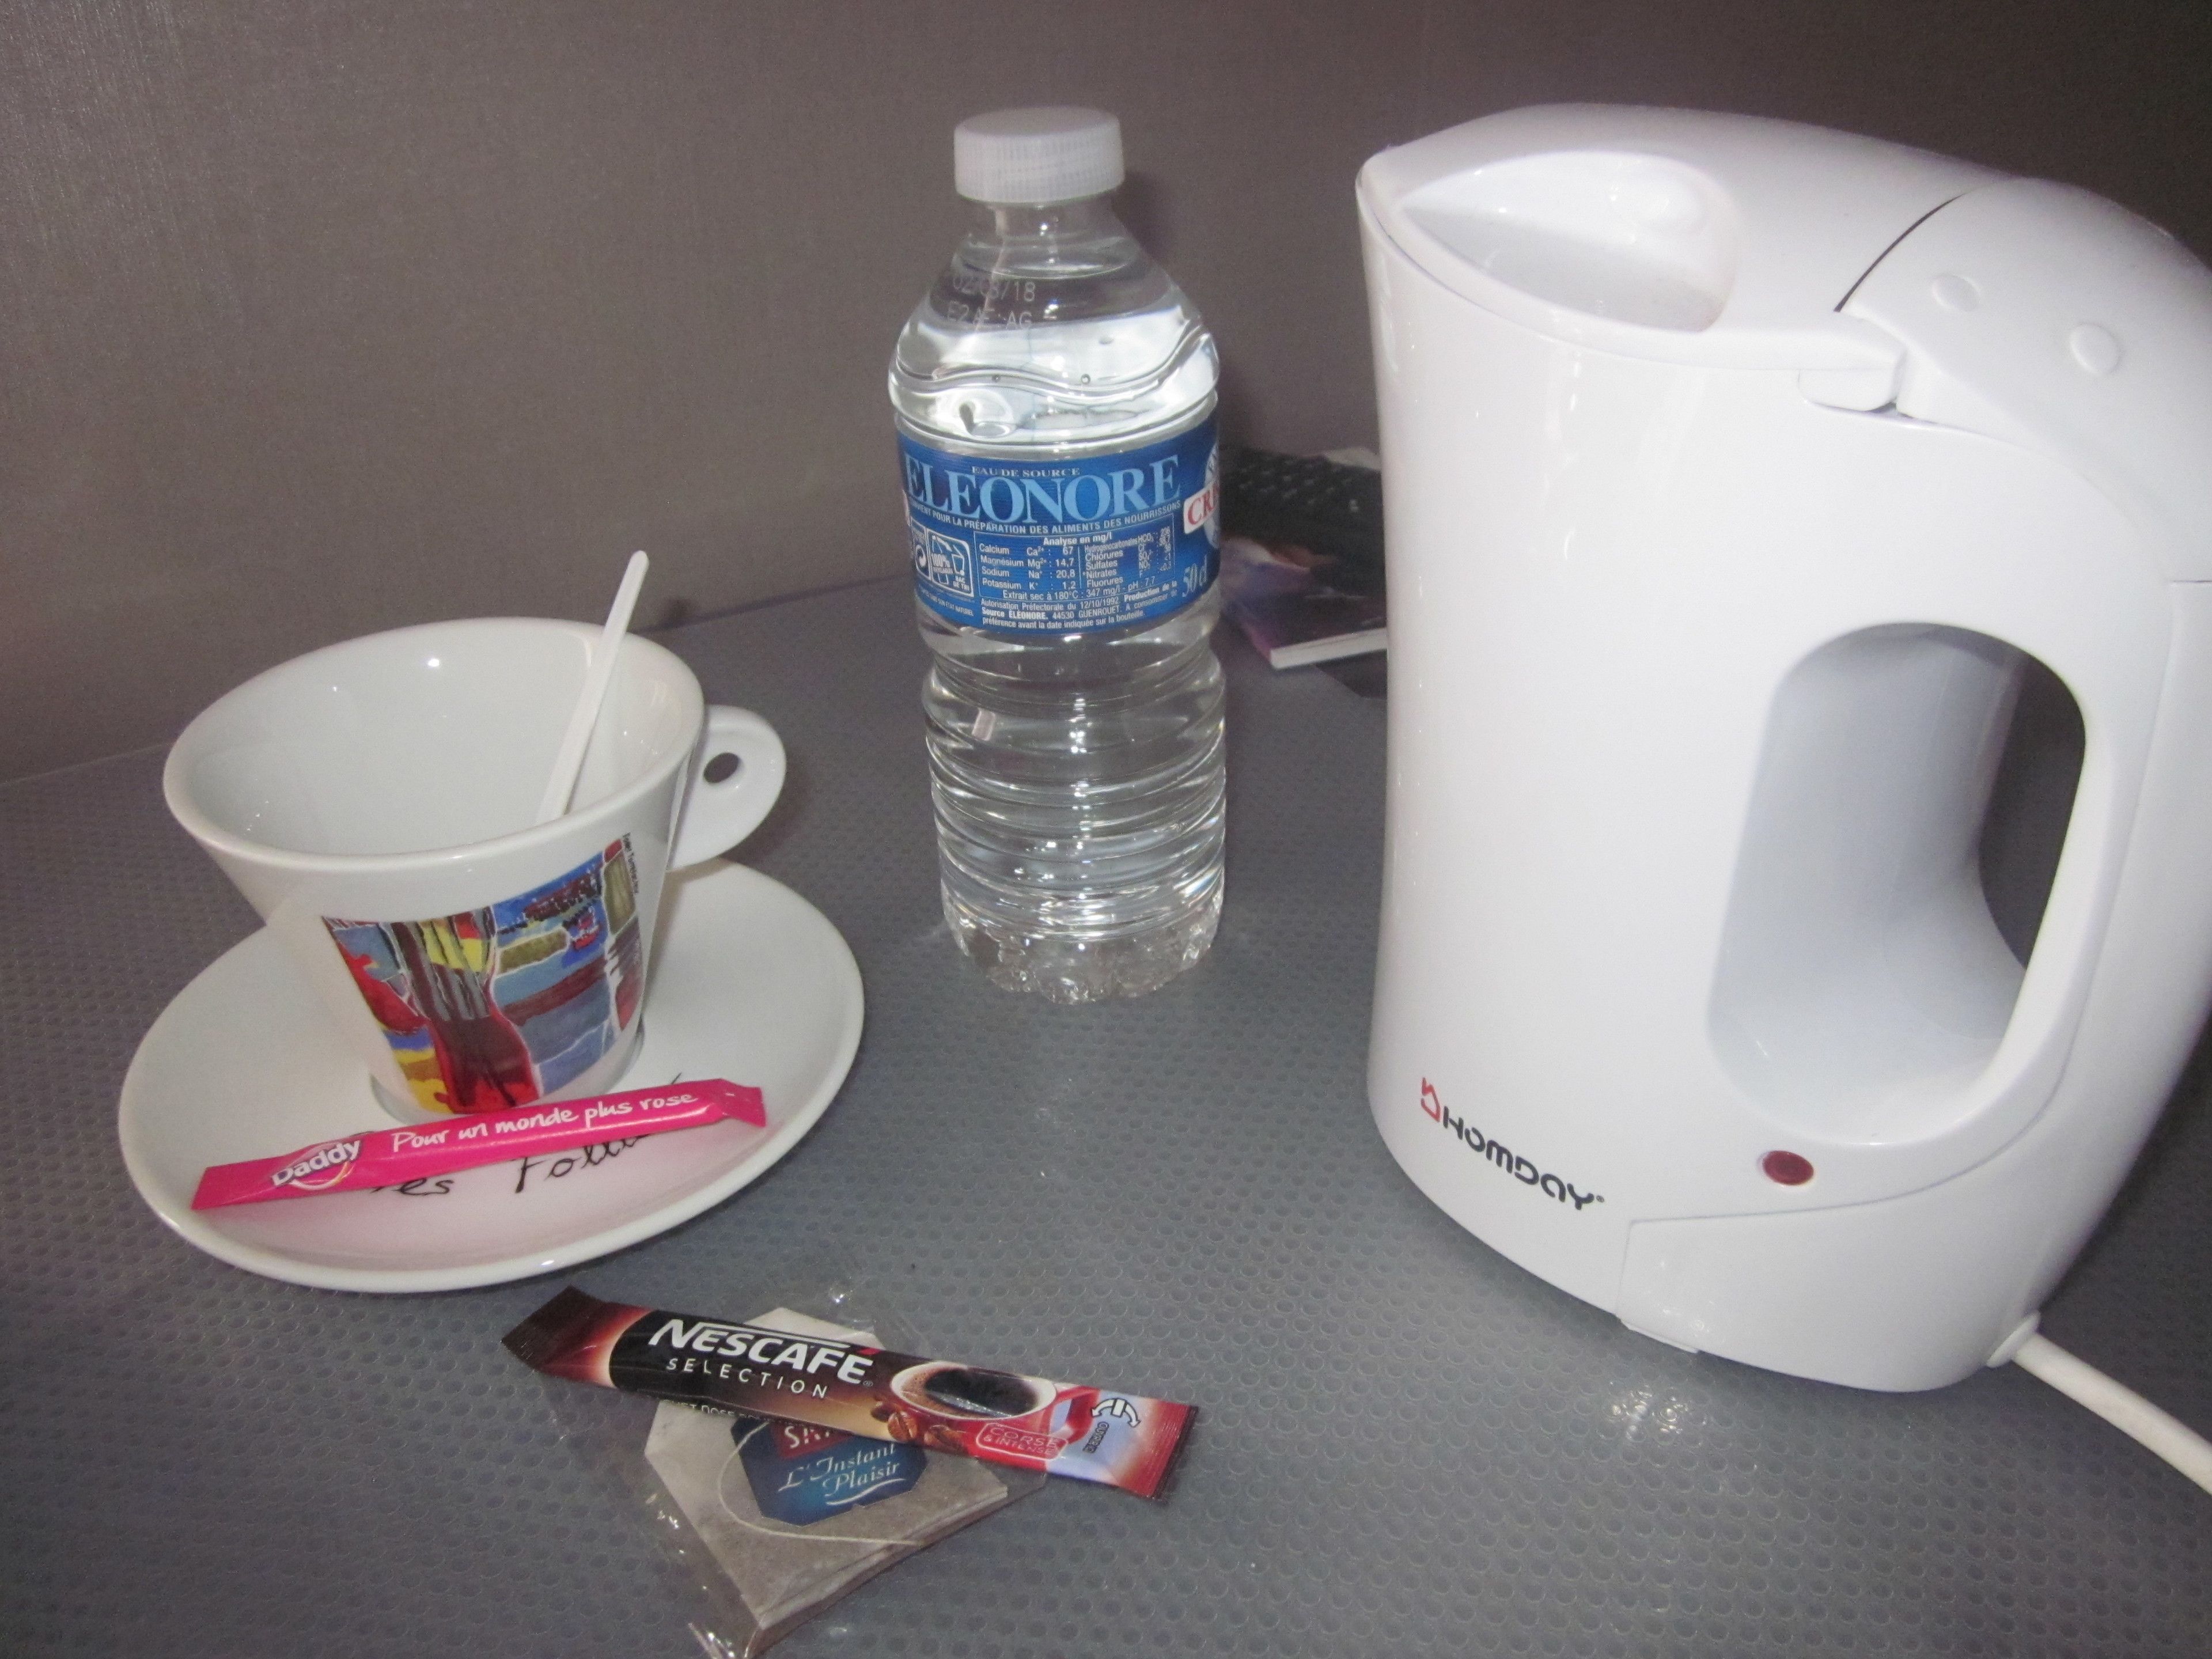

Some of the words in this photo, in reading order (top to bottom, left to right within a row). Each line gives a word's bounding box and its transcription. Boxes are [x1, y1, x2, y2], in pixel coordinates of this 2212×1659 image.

[971, 465, 998, 475] EAU
[1001, 469, 1019, 477] DE
[1022, 468, 1081, 478] SOURCE
[932, 511, 951, 524] POUR
[952, 516, 963, 527] LA
[964, 520, 1027, 534] PRÉPARATION
[1029, 525, 1048, 534] DES
[1051, 521, 1101, 534] ALIMENTS
[1104, 517, 1122, 529] DES
[1124, 501, 1181, 524] NOURRISSONS
[1043, 537, 1077, 546] Analyse
[1092, 532, 1112, 543] mg/l
[979, 543, 1010, 555] Calcium
[1062, 546, 1074, 555] 67
[980, 555, 1024, 567] Magnésium
[1055, 558, 1074, 567] 14,7
[1085, 550, 1124, 562] Chlorures
[1086, 560, 1118, 571] Sulfates
[982, 566, 1010, 577] Sodium
[1056, 569, 1075, 579] 20,8
[982, 578, 1021, 589] Potassium
[1062, 581, 1076, 590] 1,2
[1086, 577, 1124, 588] Fluorures
[1003, 590, 1028, 600] Extrait
[1047, 592, 1052, 600] à
[1086, 588, 1100, 597] 347
[1103, 584, 1120, 596] mg/l
[1128, 580, 1138, 592] pH
[981, 598, 1019, 610] Autorisation
[1022, 602, 1064, 611] Préfectorale
[1067, 601, 1077, 609] du
[1124, 586, 1160, 603] Production
[982, 607, 1005, 617] Source
[1052, 611, 1074, 619] 44530
[982, 616, 1016, 627] préférence
[1038, 620, 1045, 628] la
[1047, 620, 1062, 629] date
[1064, 617, 1094, 628] indiquée
[271, 1140, 362, 1187] Daddy
[391, 1129, 449, 1153] Pour
[459, 1122, 488, 1140] un
[495, 1108, 579, 1134] monde
[585, 1101, 633, 1128] plus
[639, 1093, 699, 1111] rose
[666, 1357, 829, 1399] SELECTION
[822, 1461, 900, 1497] Plaisir
